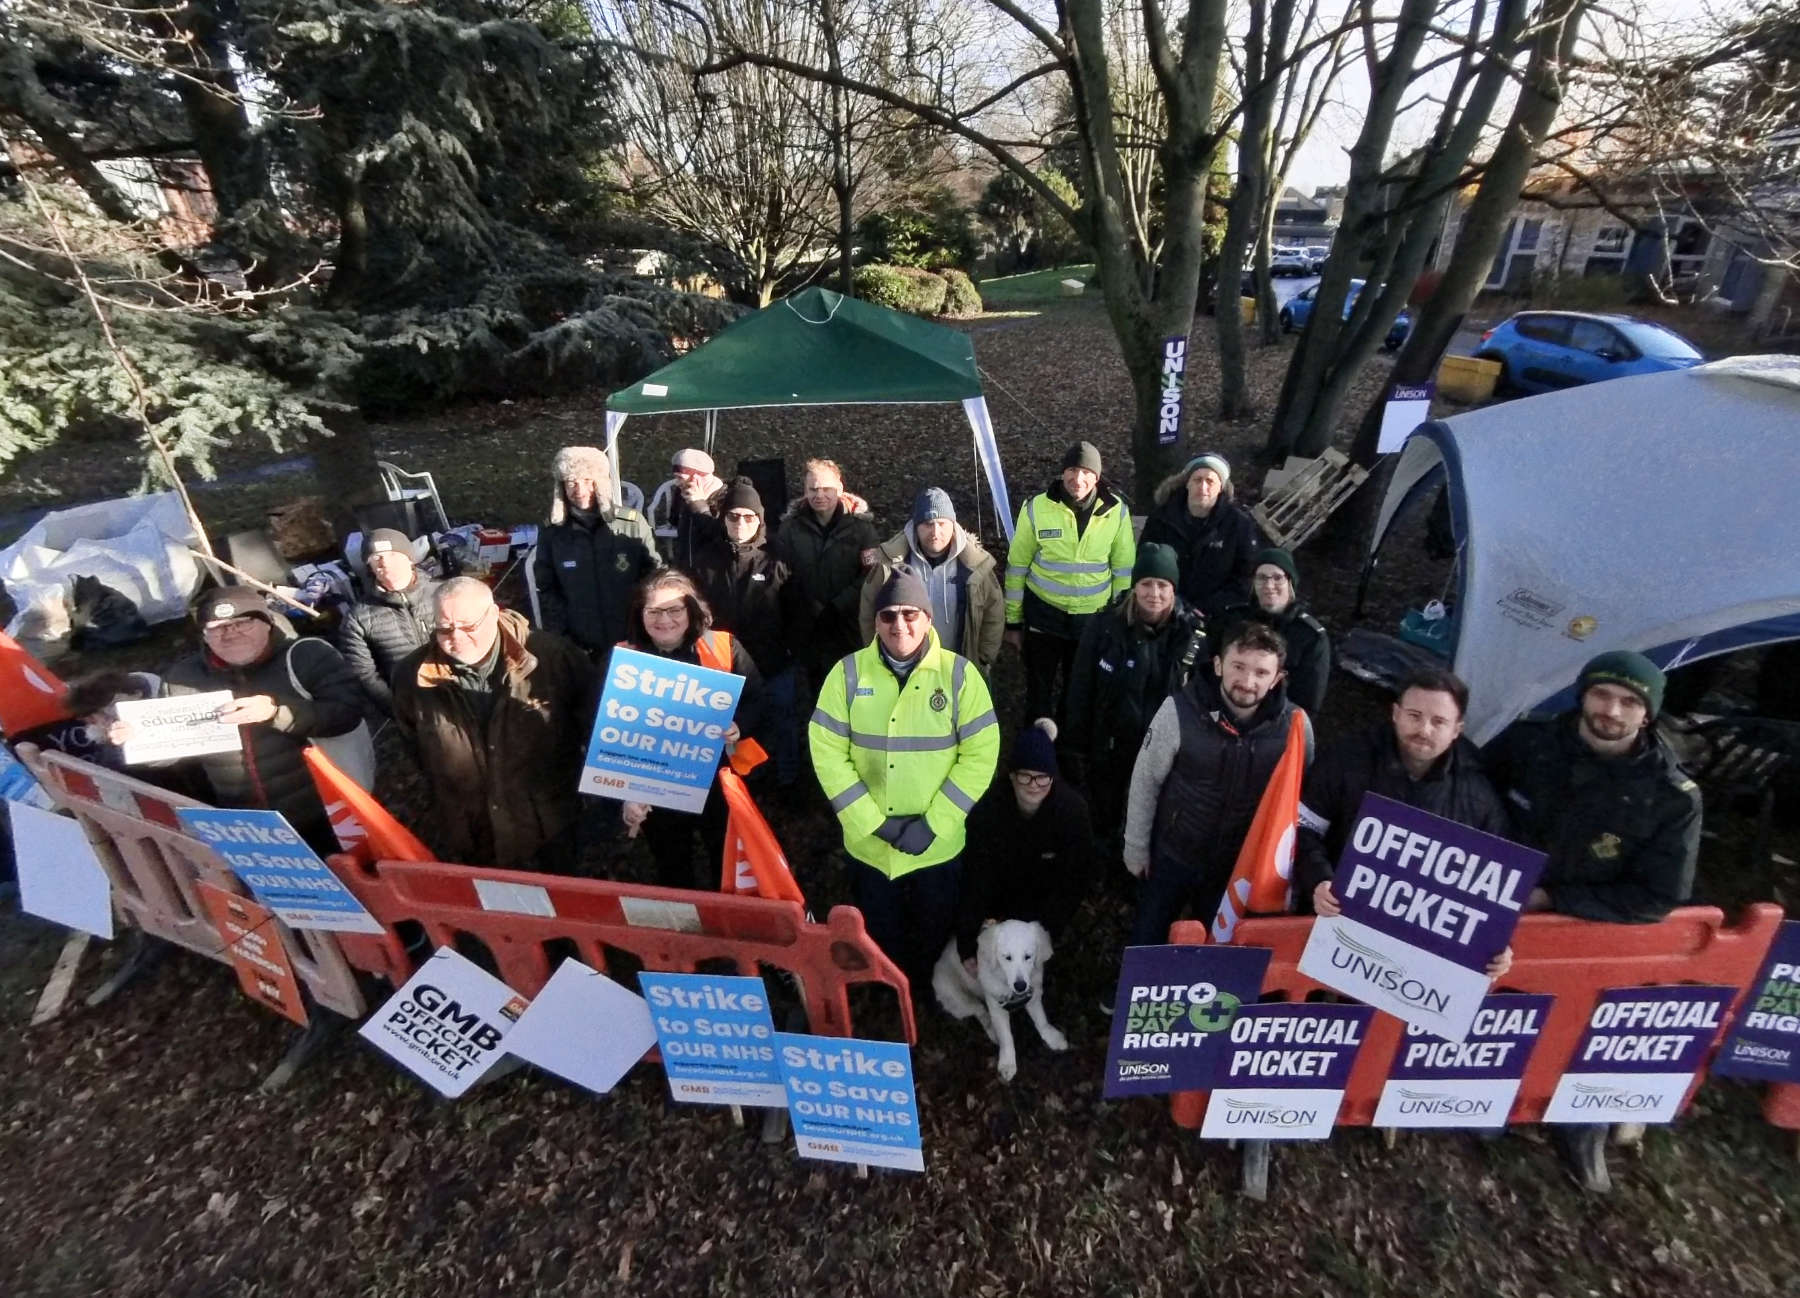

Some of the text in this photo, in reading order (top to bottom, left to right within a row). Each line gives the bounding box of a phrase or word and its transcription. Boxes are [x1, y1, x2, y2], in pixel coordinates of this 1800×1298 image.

[1160, 341, 1185, 433] UNISON
[1395, 389, 1427, 399] UNISON
[613, 663, 733, 711] Strike
[606, 698, 723, 740] to Save
[600, 726, 656, 752] OUR
[660, 739, 715, 763] NHS
[592, 775, 625, 789] GMB
[193, 820, 298, 845] Strike
[223, 852, 322, 871] to Save
[1353, 816, 1522, 912] OFFICIAL
[245, 874, 342, 892] OUR NHS
[1344, 864, 1489, 945] PICKET
[1331, 947, 1451, 1013] UNISON
[649, 984, 763, 1012] Strike
[1130, 985, 1188, 1002] PUT
[411, 984, 502, 1052] GMB
[1128, 1002, 1186, 1018] NHS
[1590, 1001, 1721, 1029] OFFICIAL
[1745, 1011, 1800, 1034] RIG
[399, 1000, 481, 1064] OFFICIAL
[657, 1016, 769, 1039] to Save
[1126, 1017, 1176, 1033] PAY
[1230, 1017, 1361, 1046] OFFICIAL
[388, 1011, 473, 1069] PICKET
[665, 1041, 774, 1062] OUR NHS
[1123, 1032, 1208, 1049] RIGHT
[1583, 1035, 1696, 1061] PICKET
[1734, 1044, 1791, 1060] UNISON
[782, 1046, 906, 1079] Strike
[1229, 1050, 1338, 1077] PICKET
[1404, 1042, 1516, 1067] PICKET
[1119, 1063, 1169, 1075] UNISON
[789, 1075, 822, 1096] to
[828, 1081, 910, 1105] Save
[1571, 1094, 1664, 1109] UNISON
[795, 1100, 849, 1119] OUR
[855, 1107, 912, 1126] NHS
[1225, 1109, 1317, 1125] UNISON
[1399, 1100, 1493, 1114] UNISON
